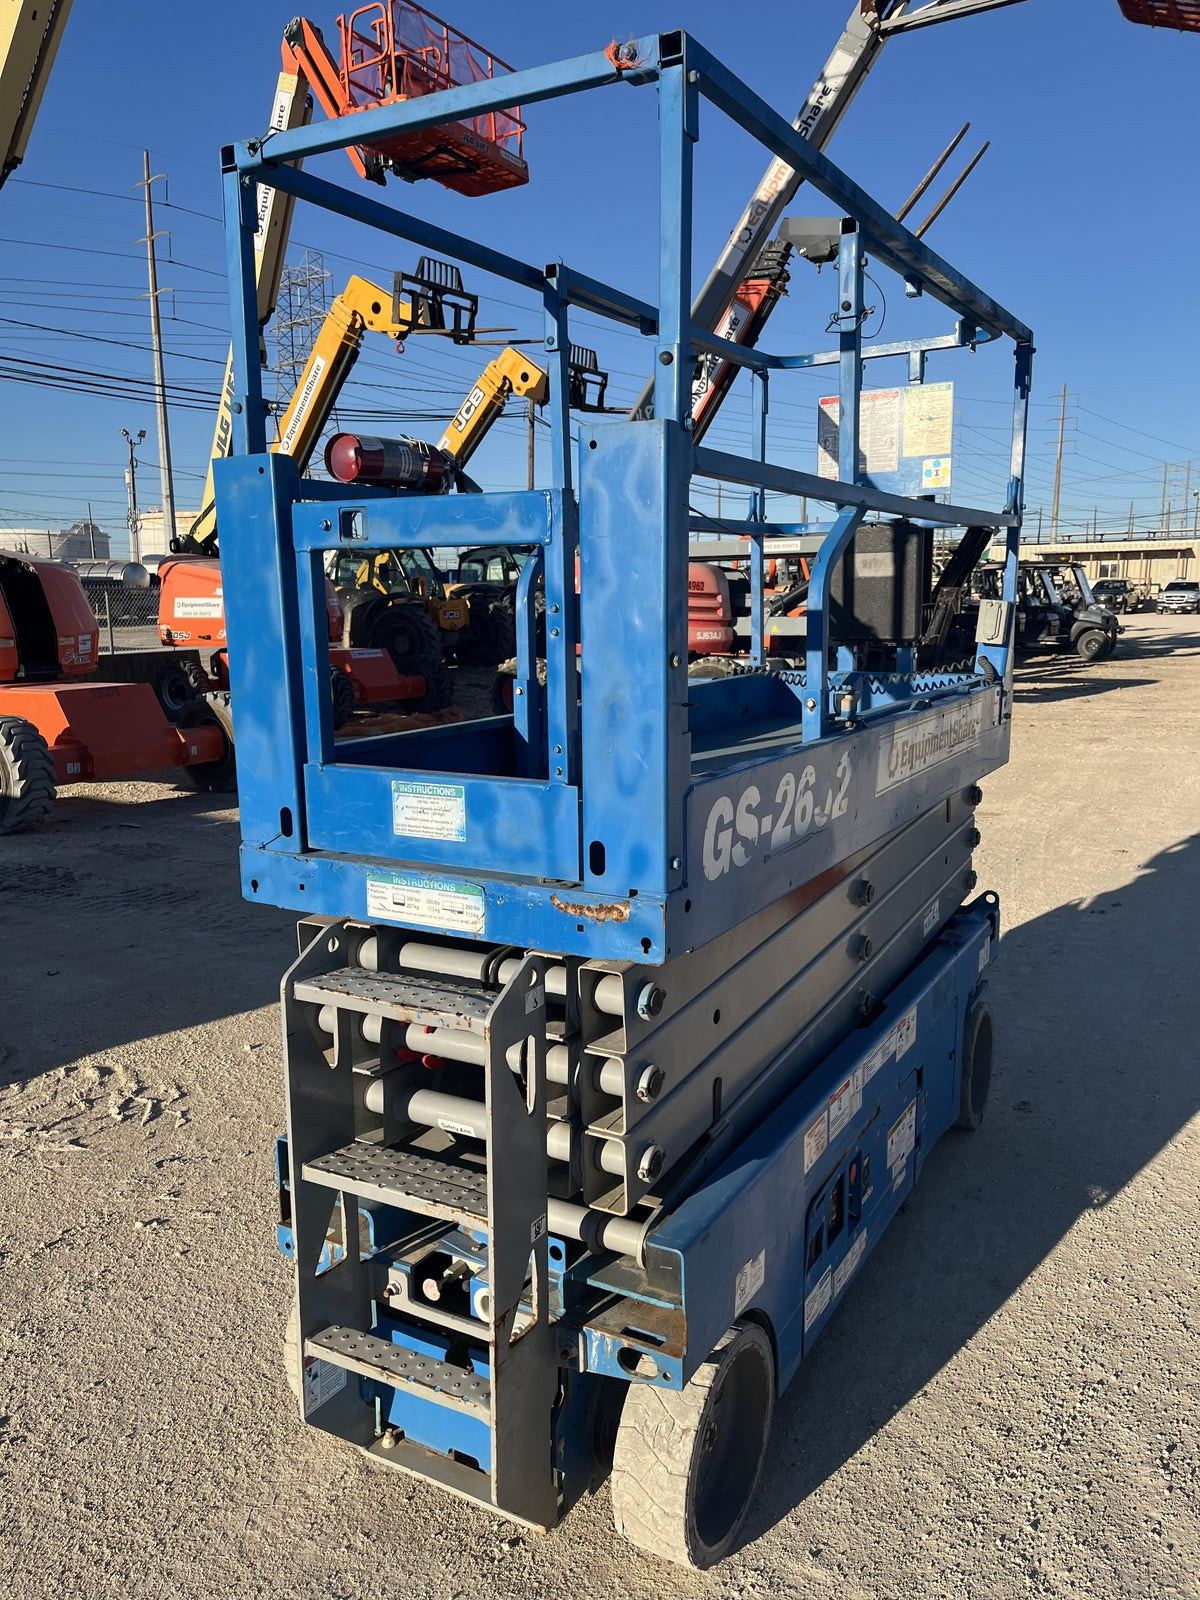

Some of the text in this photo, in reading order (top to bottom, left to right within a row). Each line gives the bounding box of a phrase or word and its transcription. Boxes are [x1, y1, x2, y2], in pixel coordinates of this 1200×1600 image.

[286, 364, 321, 441] EquipmentShare
[457, 387, 485, 432] JCB
[443, 610, 460, 619] JCB
[696, 632, 721, 640] SJ63AJ
[901, 718, 976, 770] EquipmentShare
[399, 784, 456, 796] INSTRUCTIONS
[392, 876, 456, 892] INSTRUCTIONS
